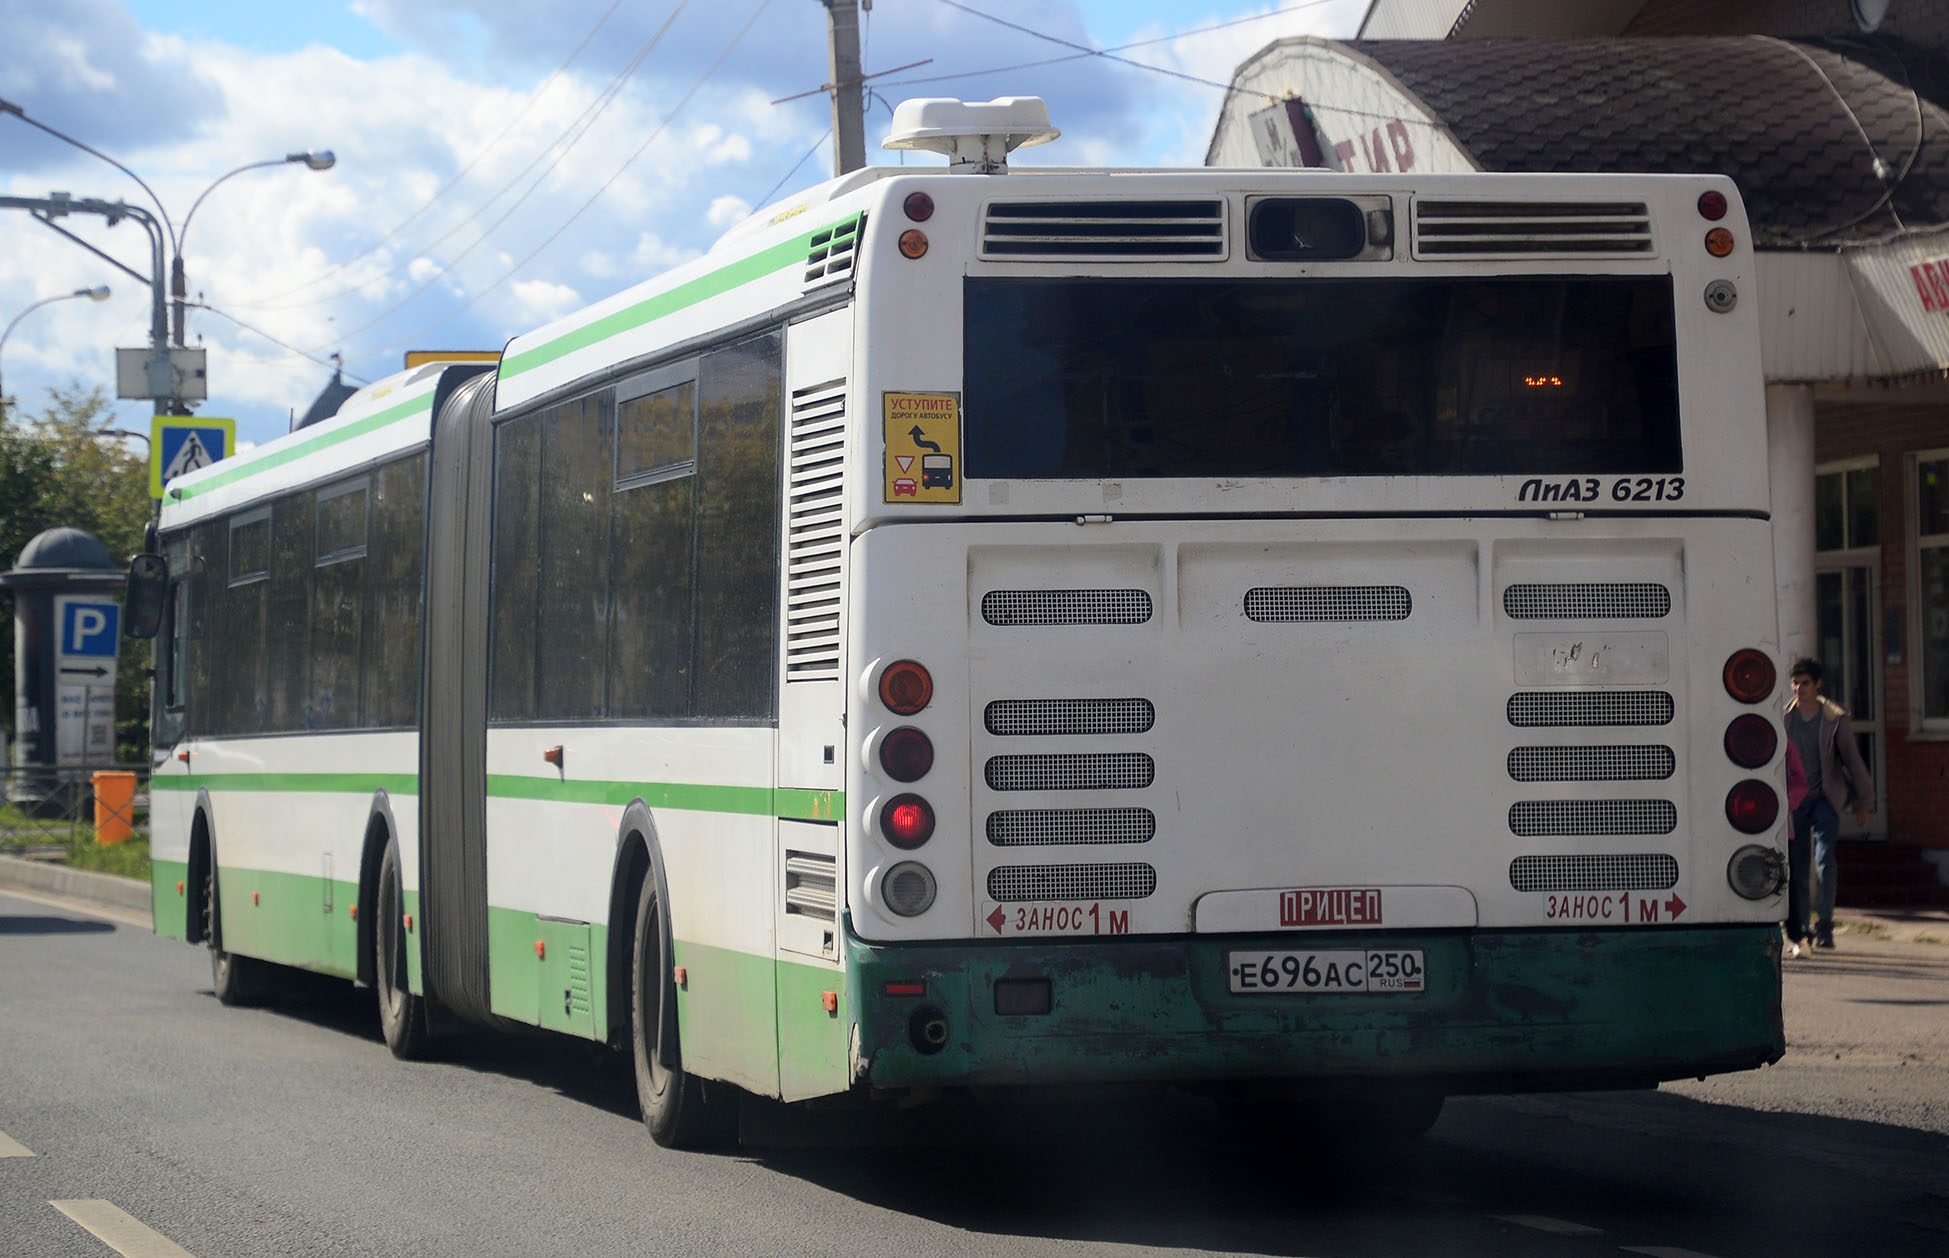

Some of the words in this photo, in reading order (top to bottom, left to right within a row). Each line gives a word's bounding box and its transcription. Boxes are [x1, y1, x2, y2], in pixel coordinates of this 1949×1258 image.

[1910, 260, 1949, 312] АВ
[891, 398, 952, 411] УСТУПИТЕ
[891, 412, 918, 420] ДОРОГУ
[919, 412, 952, 420] АВТОБУСУ
[1611, 478, 1686, 501] 6213
[73, 608, 106, 651] P
[1016, 907, 1083, 931] ЗАНОС
[1089, 903, 1100, 934] 1
[1109, 910, 1129, 934] М
[1284, 891, 1379, 925] ПРИЦЕП
[1547, 896, 1613, 919] ЗАНОС
[1619, 891, 1630, 923] 1
[1640, 899, 1659, 922] М
[1369, 953, 1415, 978] 250
[1380, 978, 1403, 988] RUS
